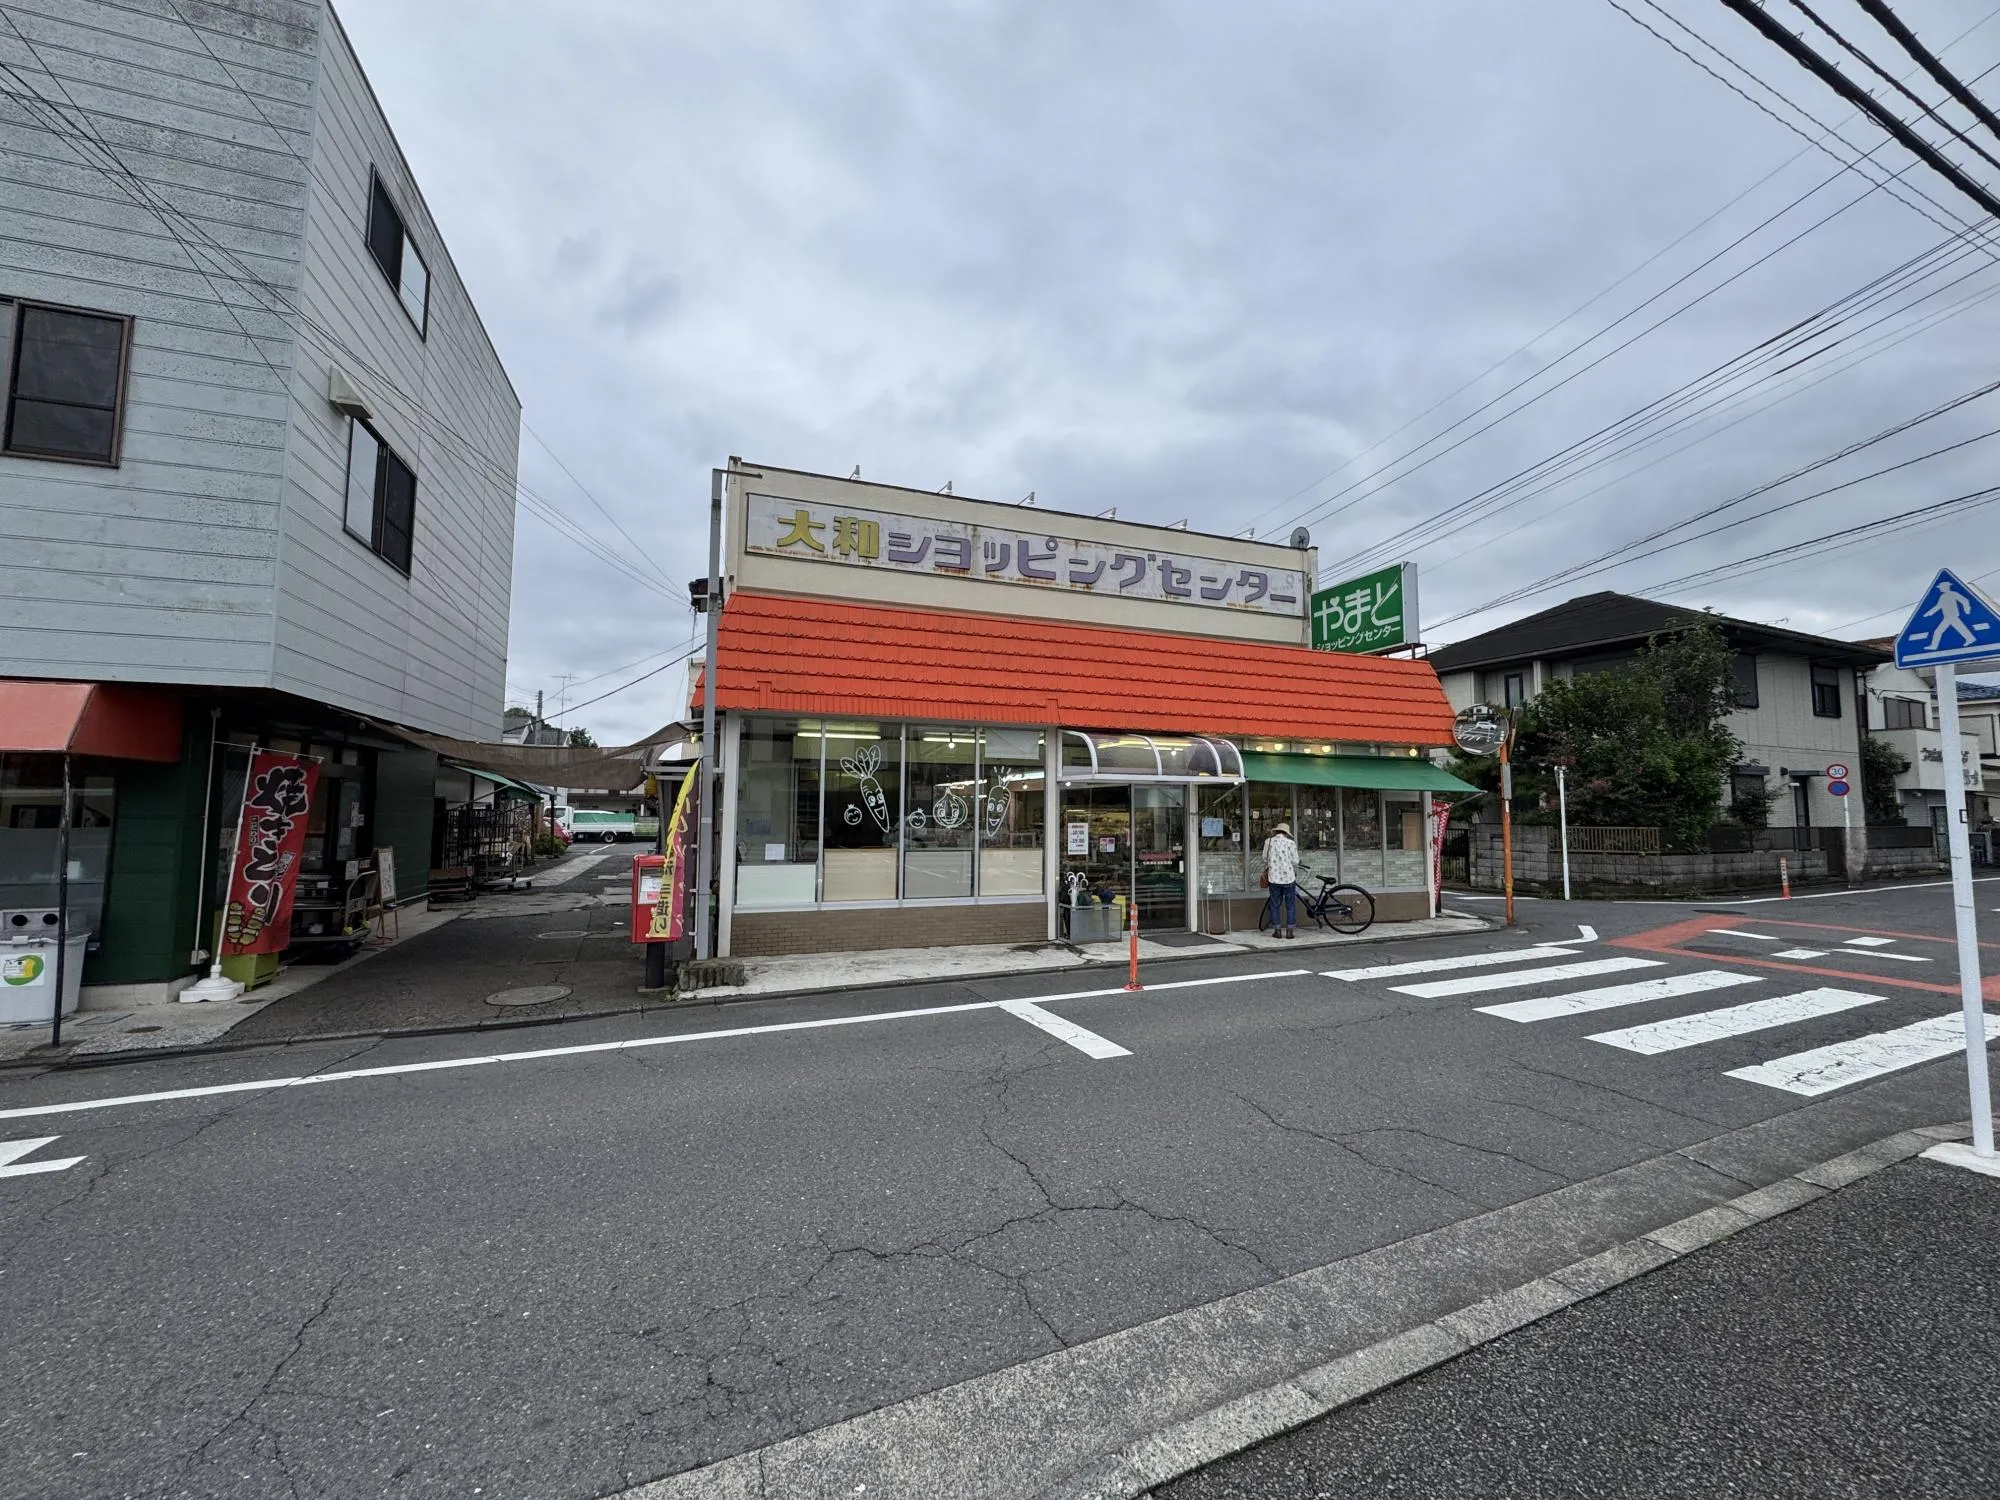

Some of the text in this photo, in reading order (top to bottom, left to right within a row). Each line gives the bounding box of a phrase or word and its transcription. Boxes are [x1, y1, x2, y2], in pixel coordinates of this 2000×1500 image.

[1313, 582, 1401, 641] やまと
[1316, 625, 1401, 653] ショッピングセンター
[1831, 767, 1844, 776] 30
